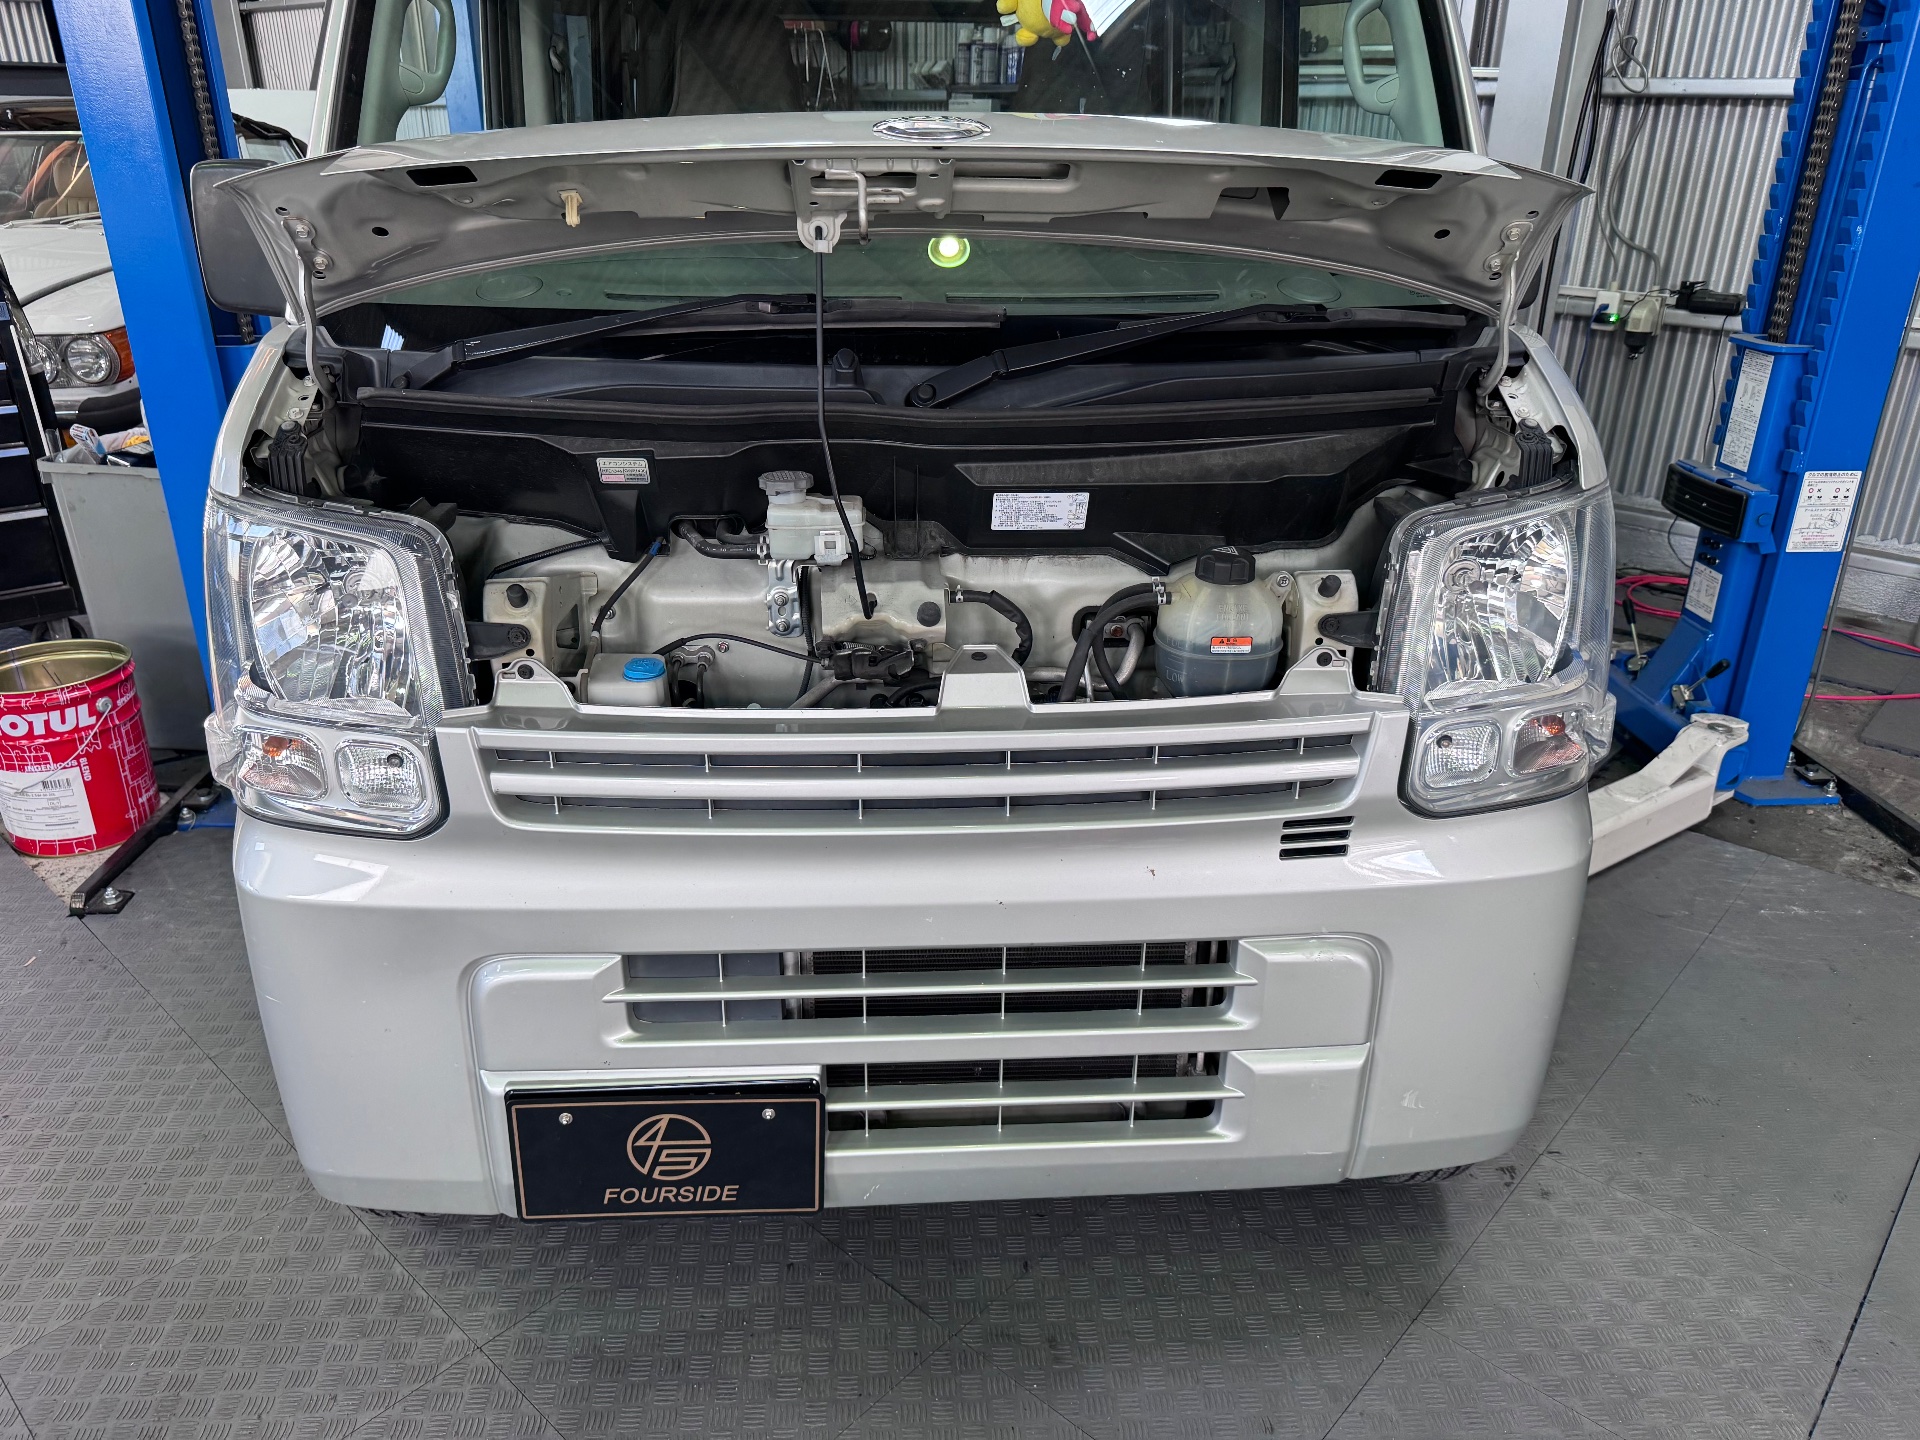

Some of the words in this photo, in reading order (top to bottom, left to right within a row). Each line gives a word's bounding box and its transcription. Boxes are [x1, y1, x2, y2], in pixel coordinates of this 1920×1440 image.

[0, 704, 97, 738] OTUL
[24, 759, 78, 772] INGENIOUS
[79, 757, 92, 782] BLEND
[603, 1185, 740, 1205] FOURSIDE
